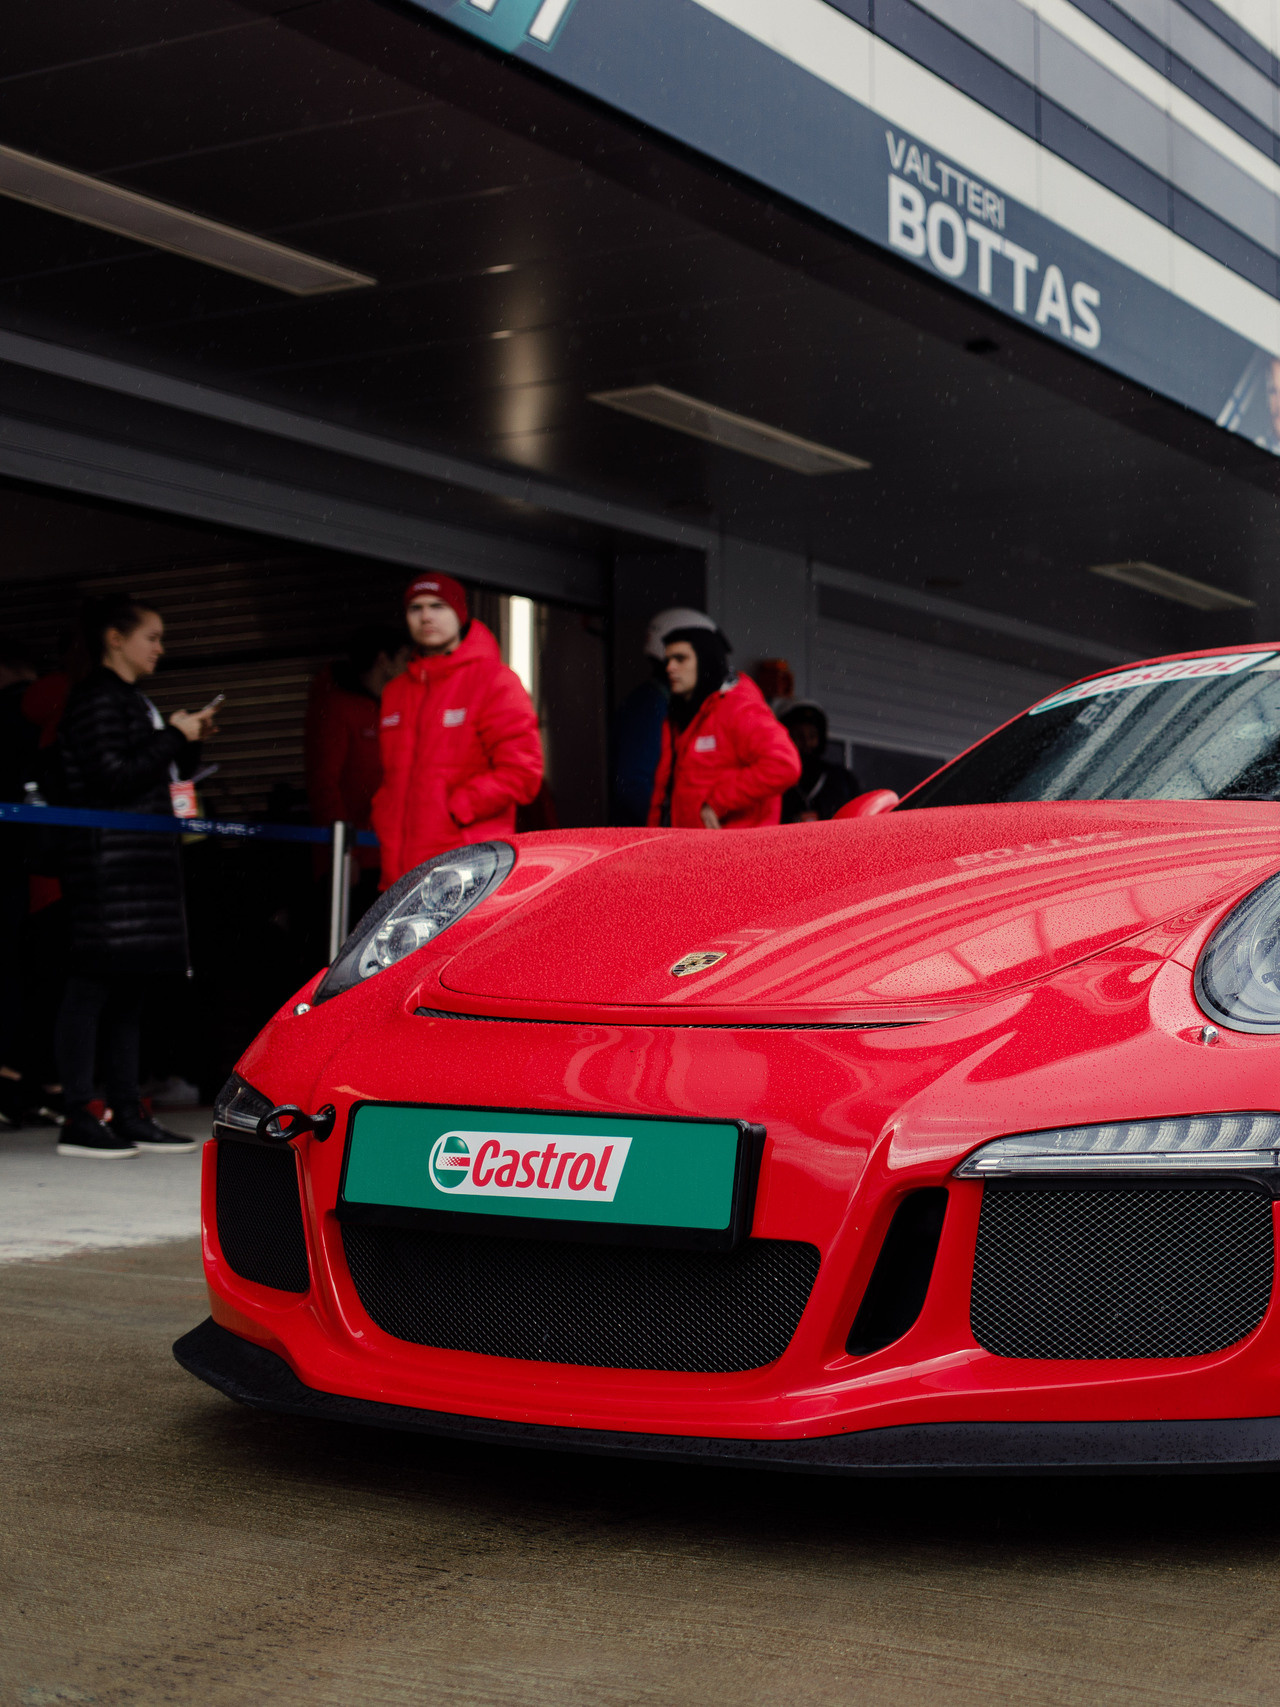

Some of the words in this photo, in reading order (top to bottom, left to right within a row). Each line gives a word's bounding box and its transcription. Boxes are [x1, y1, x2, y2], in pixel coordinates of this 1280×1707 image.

[885, 130, 1005, 229] VALTTERI
[887, 173, 1101, 350] BOTTAS
[471, 1138, 615, 1193] Castrol
